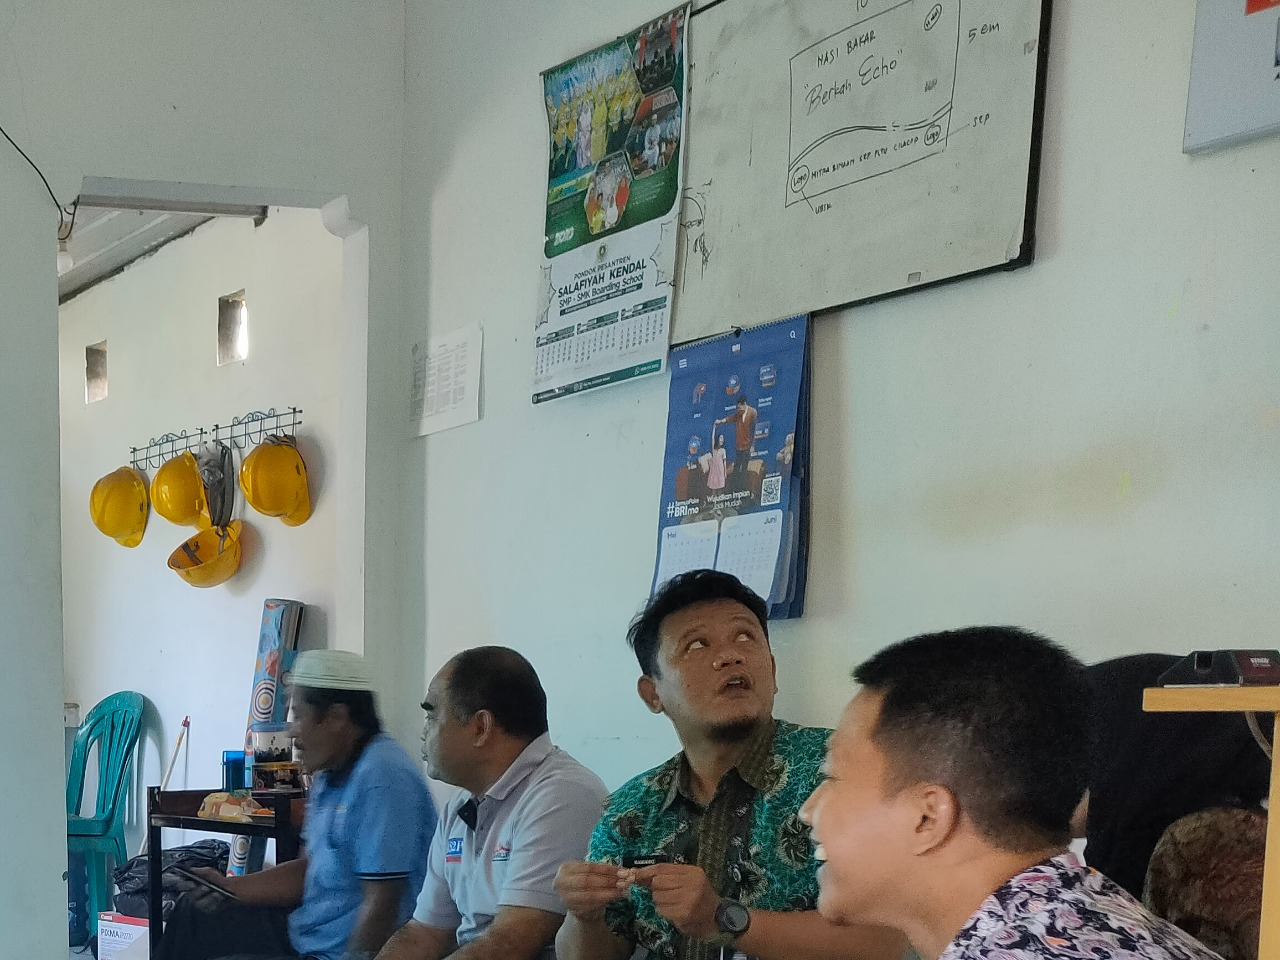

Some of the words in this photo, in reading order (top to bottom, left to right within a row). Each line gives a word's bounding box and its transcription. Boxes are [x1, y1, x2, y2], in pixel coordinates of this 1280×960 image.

[817, 47, 840, 67] NASI
[846, 30, 876, 54] BAKAR
[558, 272, 606, 299] SALAFIYAH
[609, 258, 648, 280] KENDAL
[591, 280, 621, 297] Boarding
[622, 271, 645, 288] School
[100, 928, 120, 939] PIXMA
